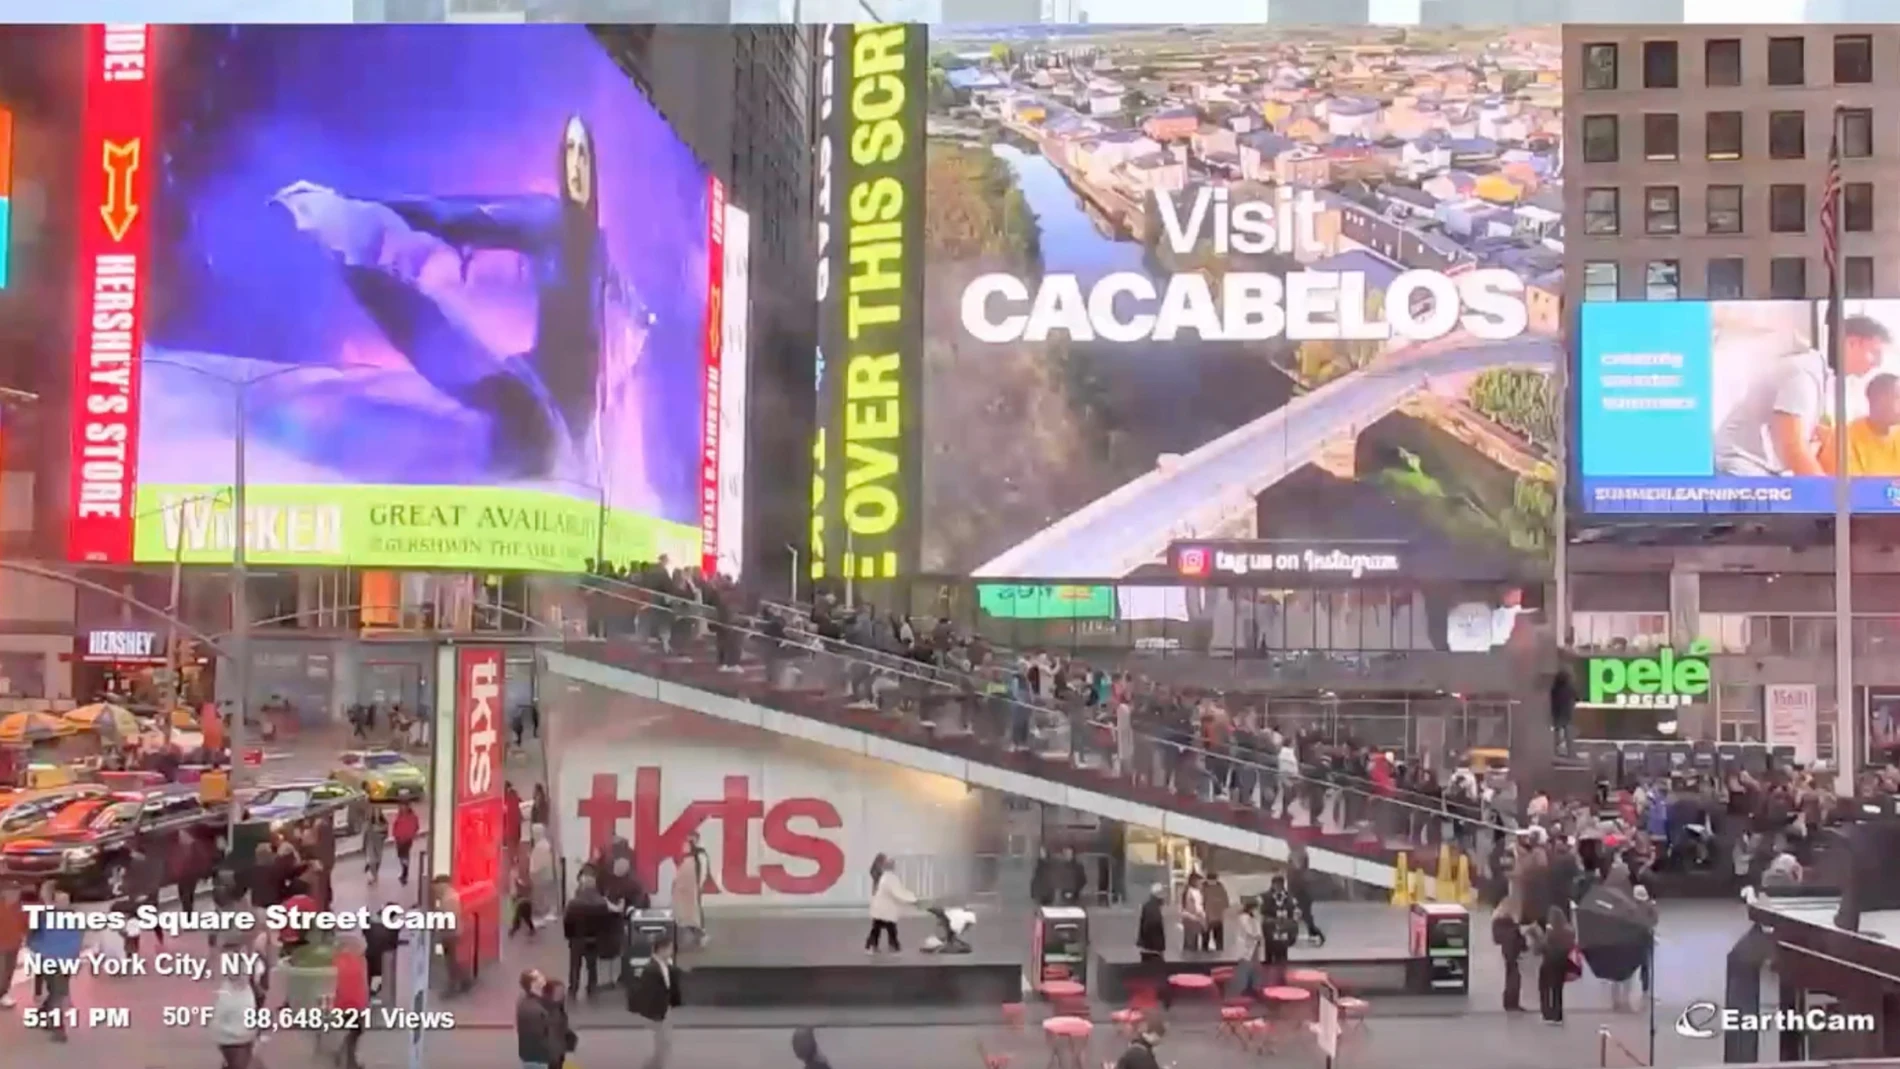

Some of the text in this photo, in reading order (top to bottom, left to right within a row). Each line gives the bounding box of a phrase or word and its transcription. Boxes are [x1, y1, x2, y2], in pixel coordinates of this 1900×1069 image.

[851, 22, 906, 166] SCR
[849, 177, 904, 339] THIS
[1153, 187, 1327, 255] Visit
[86, 254, 136, 414] HERSHEY'S
[960, 269, 1529, 342] CACABELOS
[78, 422, 128, 519] STORE
[844, 352, 900, 535] OVER
[370, 504, 465, 526] GREAT
[1276, 553, 1299, 570] on
[469, 657, 498, 795] tkts
[1589, 639, 1710, 704] pelé
[577, 766, 845, 895] tkts
